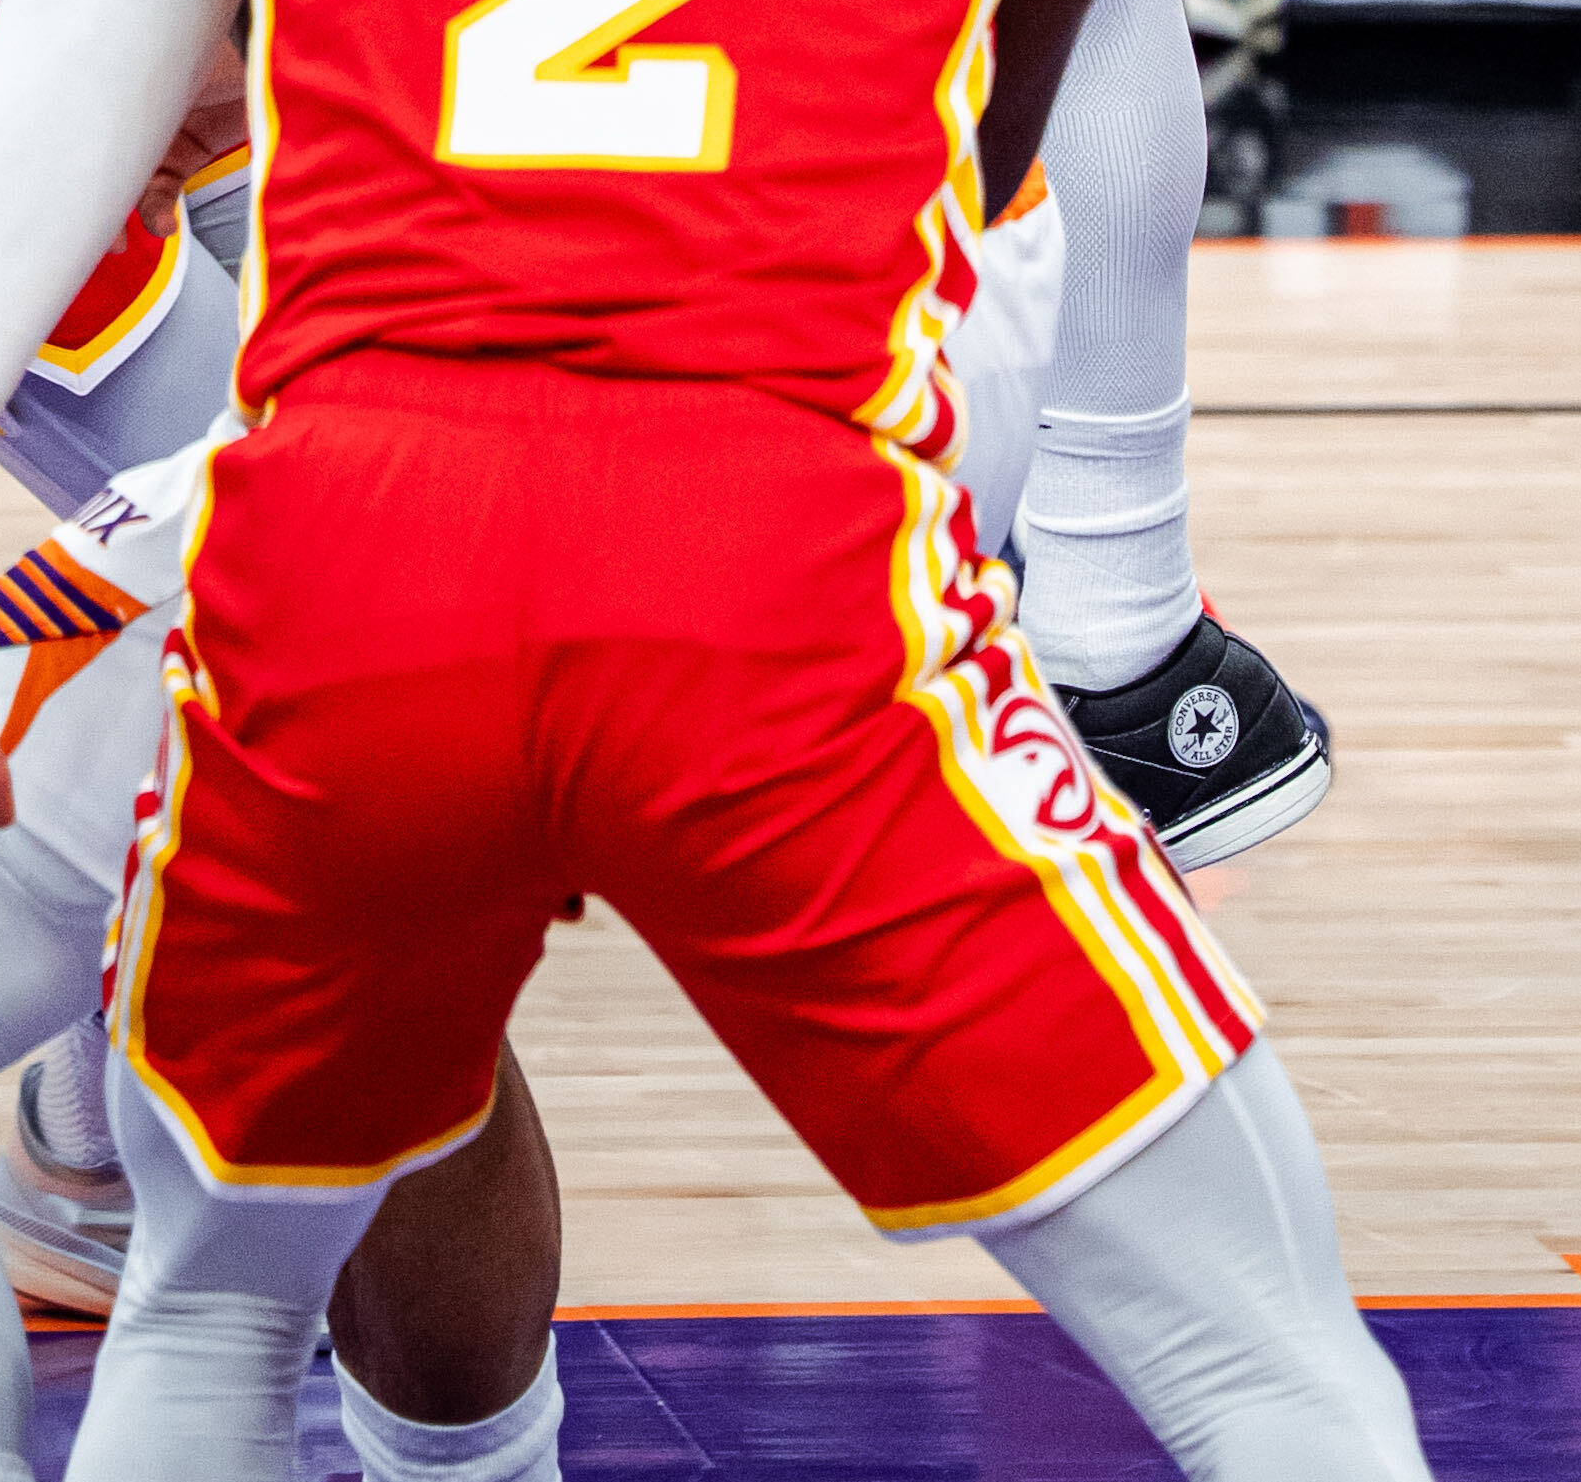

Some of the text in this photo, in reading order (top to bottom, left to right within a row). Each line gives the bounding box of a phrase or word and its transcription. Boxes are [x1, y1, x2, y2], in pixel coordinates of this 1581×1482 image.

[1175, 691, 1220, 736] CONVERSE
[1191, 750, 1212, 761] ALL
[1214, 725, 1233, 755] STAR
